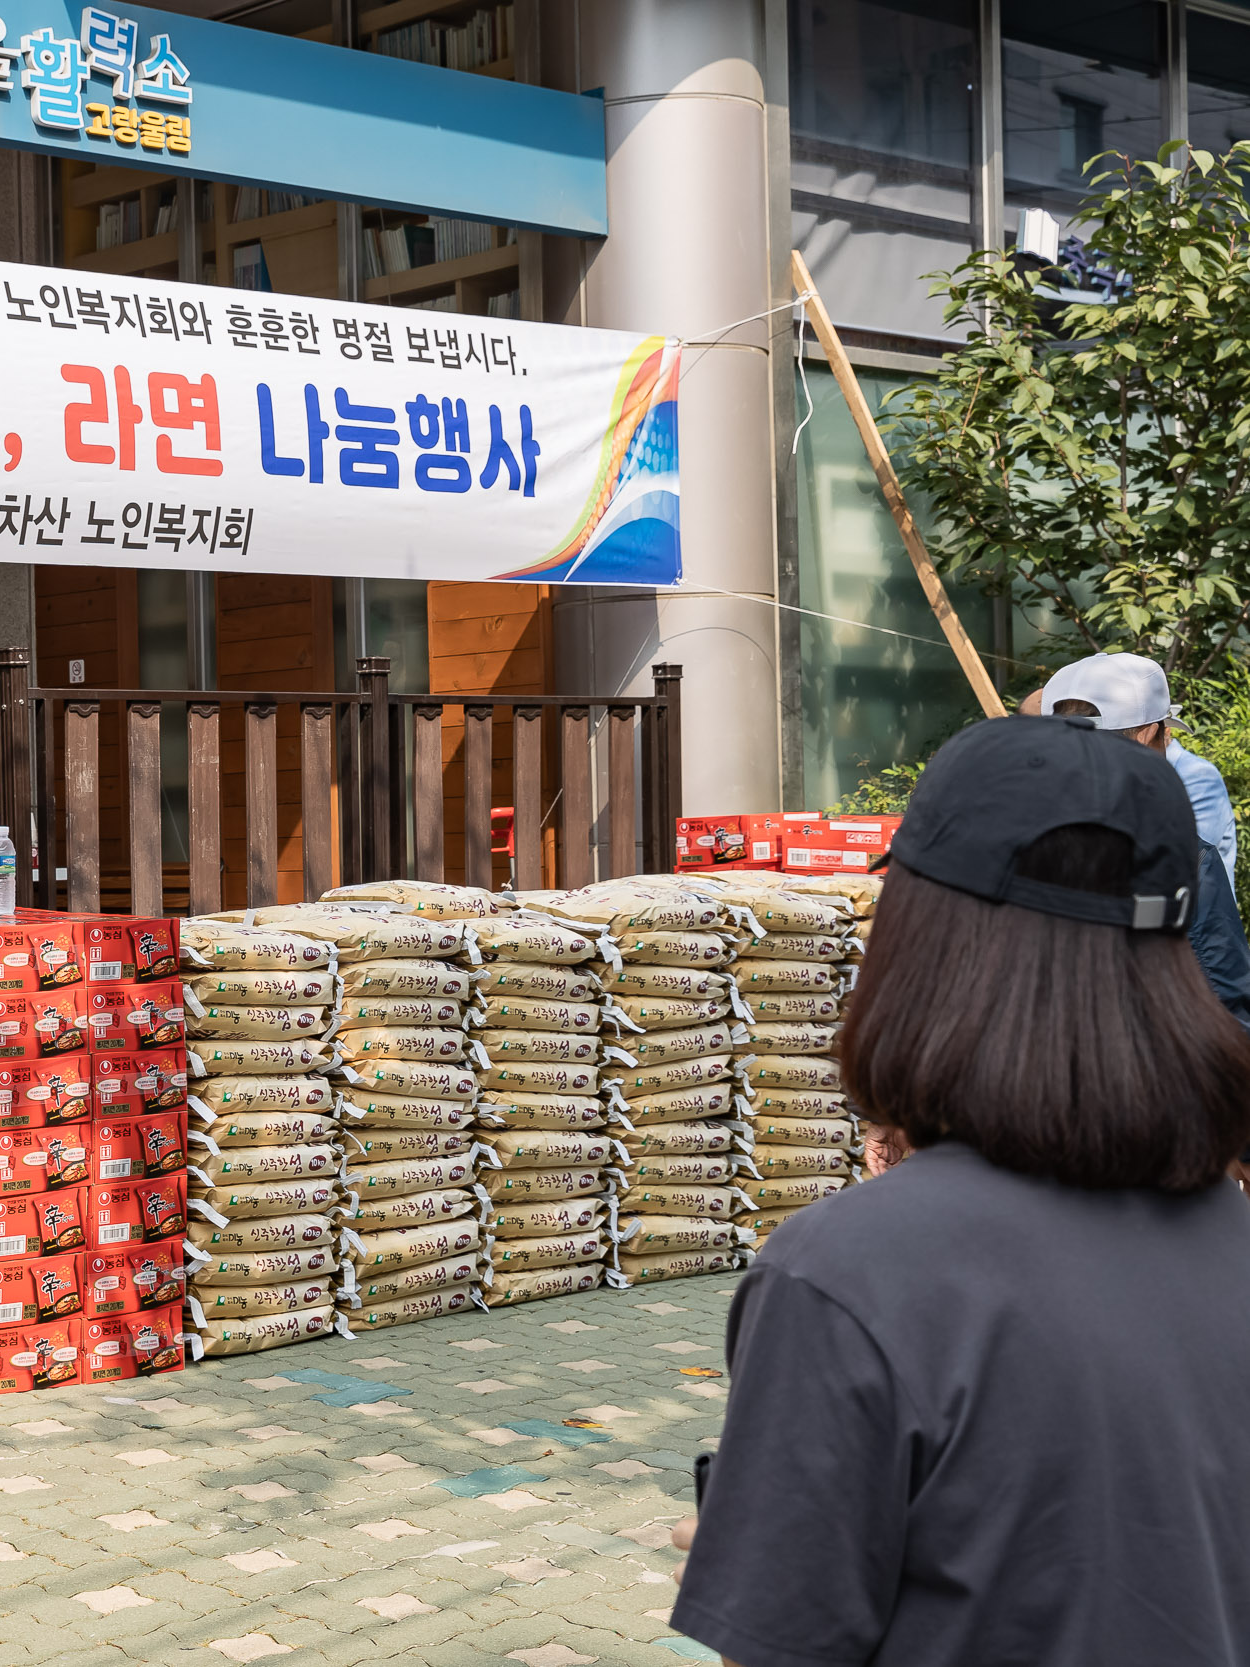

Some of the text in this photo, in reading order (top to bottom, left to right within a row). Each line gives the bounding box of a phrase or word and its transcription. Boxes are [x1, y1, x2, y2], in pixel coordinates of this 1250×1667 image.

[4, 280, 212, 344] 노인복지회와
[225, 304, 321, 355] 훈훈한
[333, 316, 395, 363] 명절
[406, 326, 528, 376] 보냅시다.
[60, 363, 224, 477] 라면
[256, 382, 541, 498] 나눔행사
[80, 498, 254, 555] 노인복지회
[689, 823, 704, 832] 농심
[103, 930, 122, 939] 농심
[4, 936, 24, 946] 농심
[106, 996, 125, 1006] 농심
[12, 1072, 31, 1082] 농심
[112, 1128, 131, 1137] 농심
[13, 1137, 32, 1147] 농심
[111, 1192, 130, 1202] 농심
[7, 1204, 26, 1214] 농심
[105, 1259, 125, 1268] 농심
[3, 1271, 23, 1281] 농심
[102, 1325, 121, 1334] 농심
[0, 1337, 18, 1347] 농심
